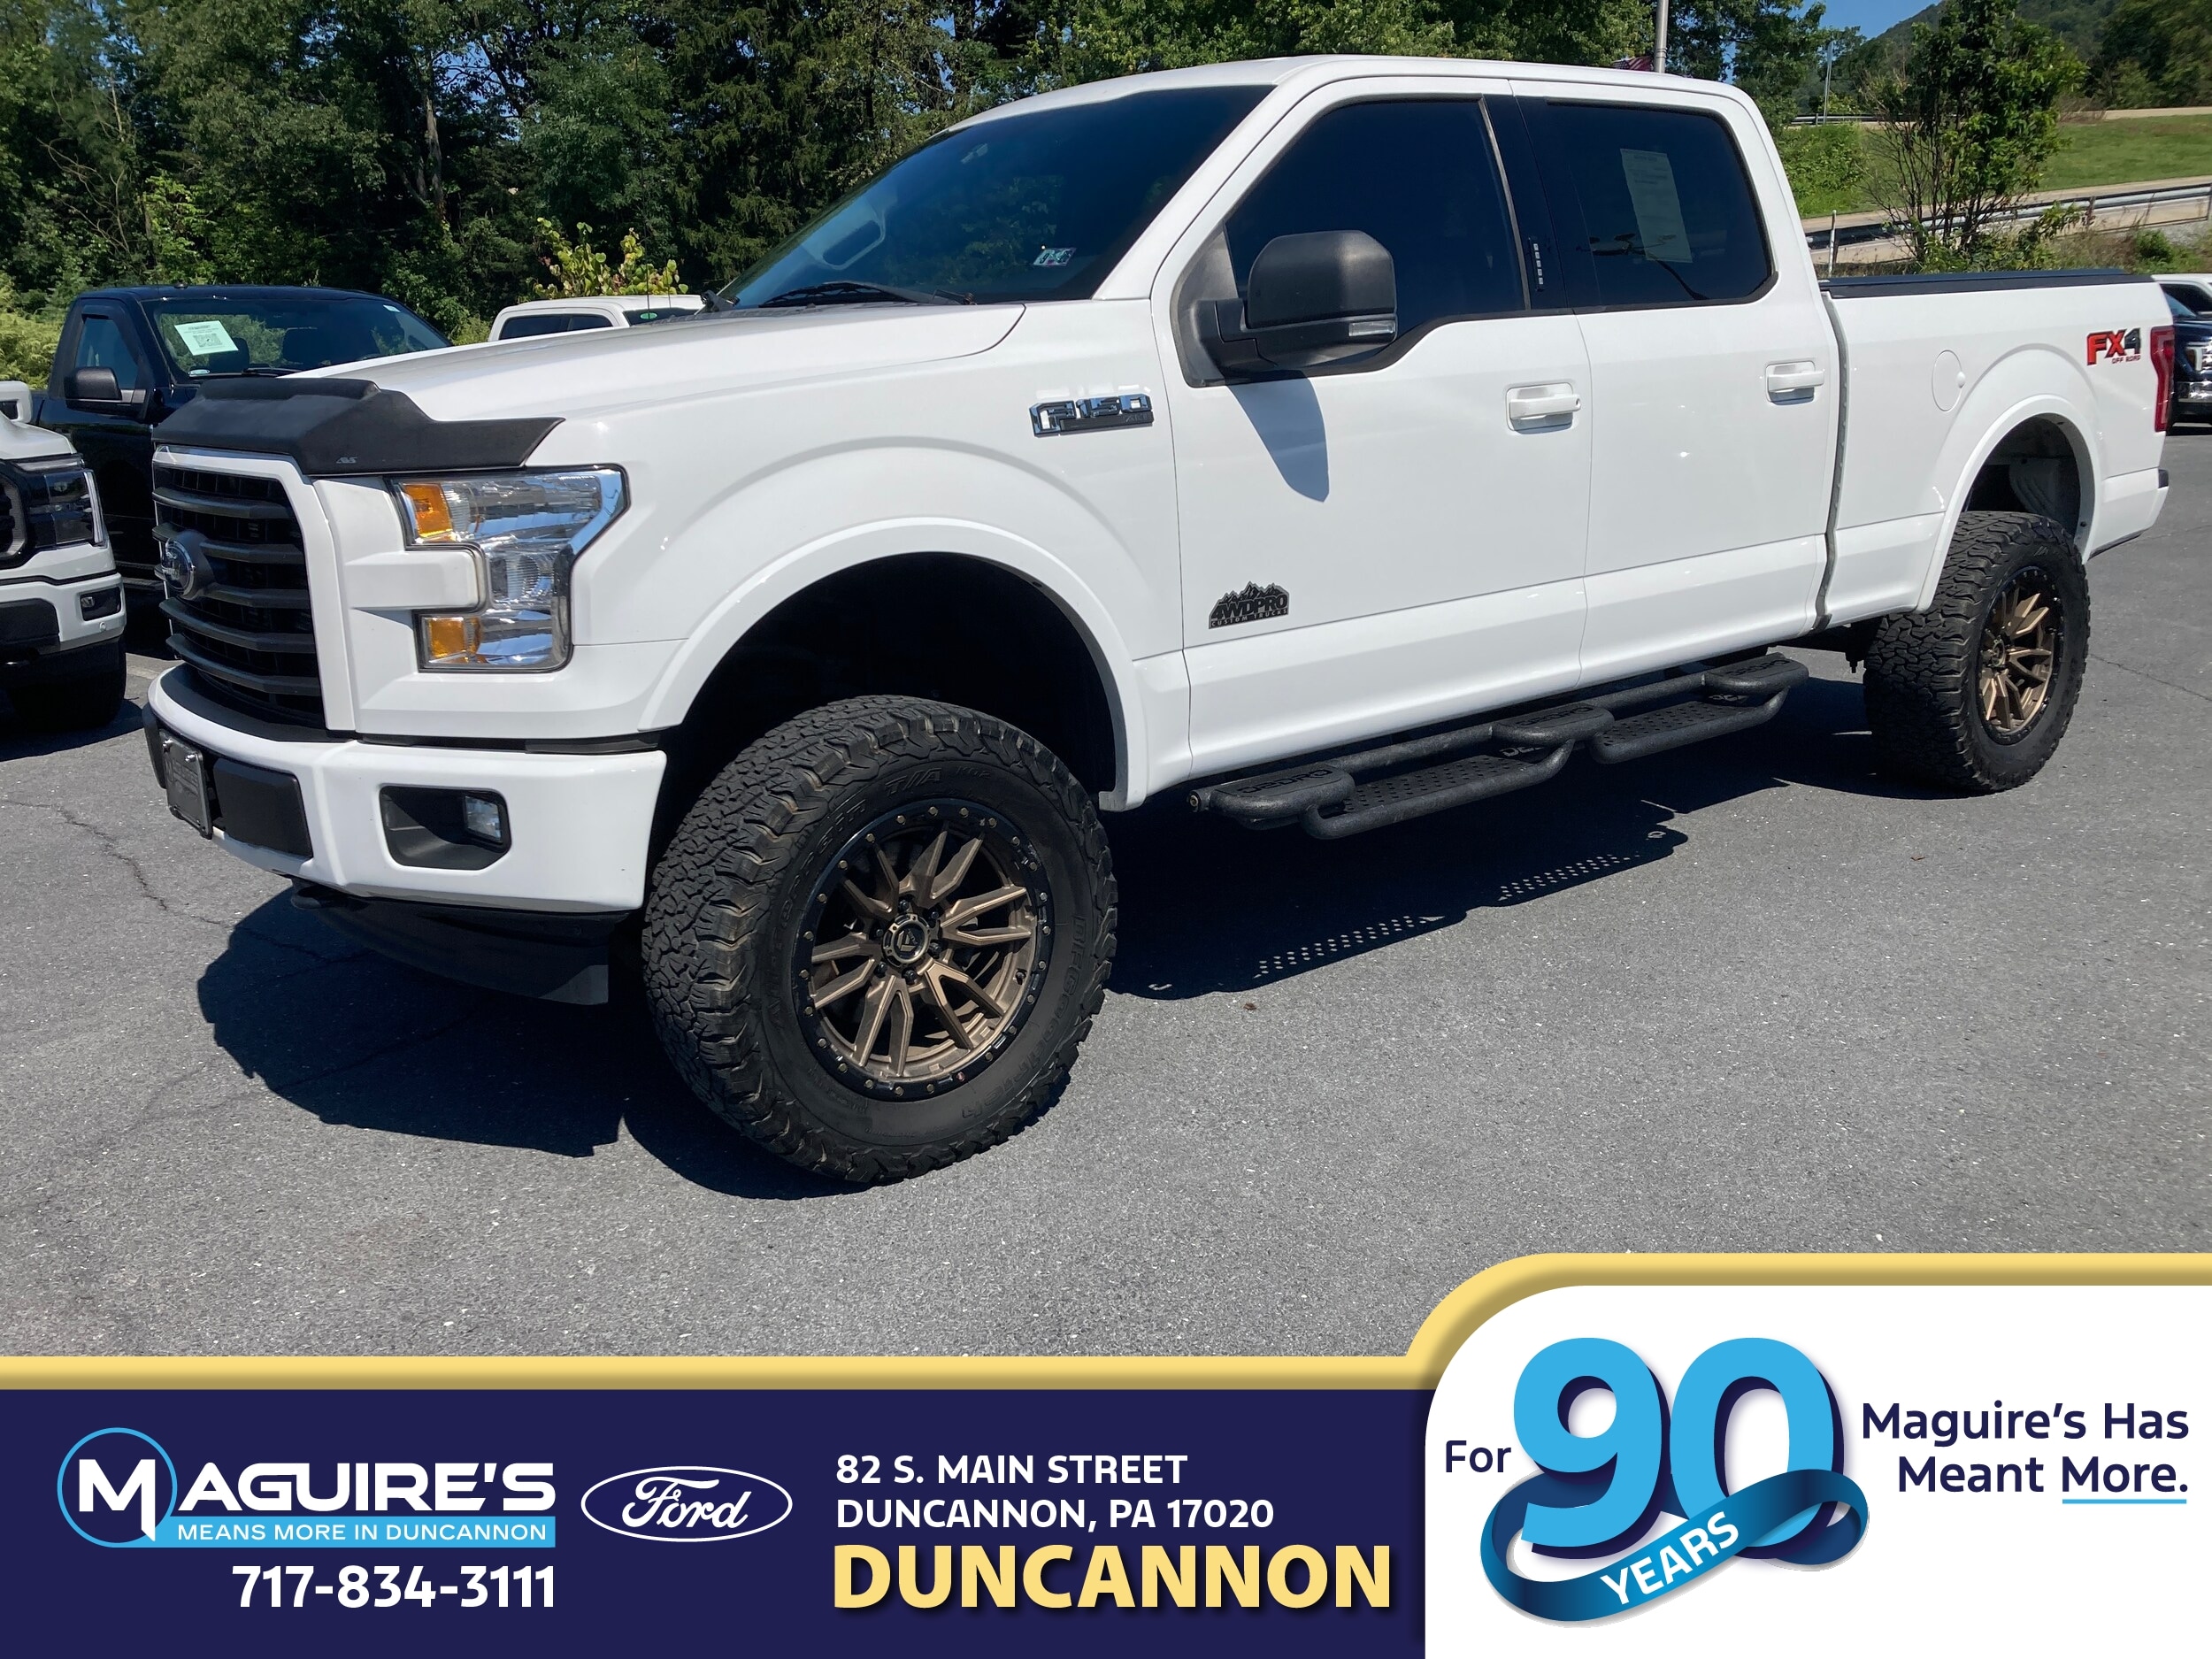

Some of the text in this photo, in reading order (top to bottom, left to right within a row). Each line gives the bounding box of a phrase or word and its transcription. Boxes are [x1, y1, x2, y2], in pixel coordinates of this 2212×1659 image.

[2086, 327, 2141, 365] FX4
[1210, 593, 1288, 620] 4WDPRO
[1211, 608, 1288, 627] CUSTOM TRUCKS
